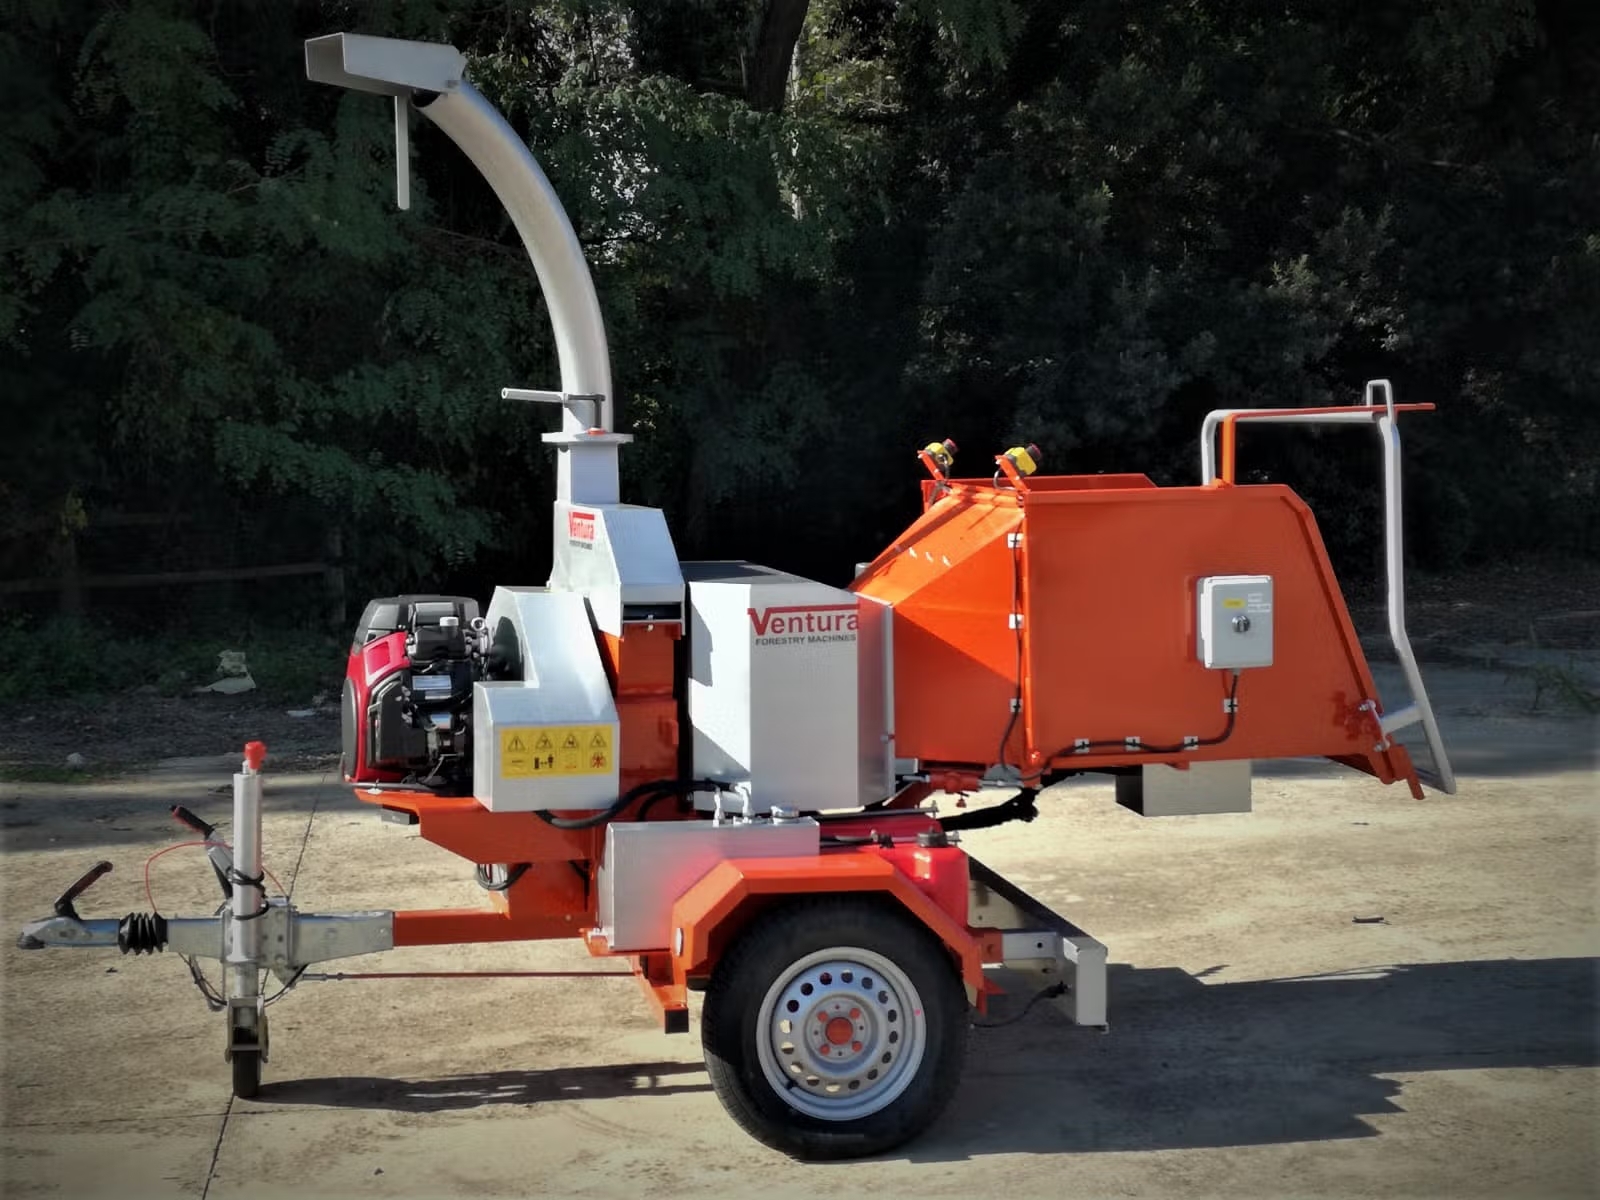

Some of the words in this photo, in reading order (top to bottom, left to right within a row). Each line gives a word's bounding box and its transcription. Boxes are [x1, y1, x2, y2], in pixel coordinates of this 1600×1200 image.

[747, 604, 860, 636] Ventura
[755, 636, 805, 646] FORESTRY
[807, 634, 857, 643] MACHINES
